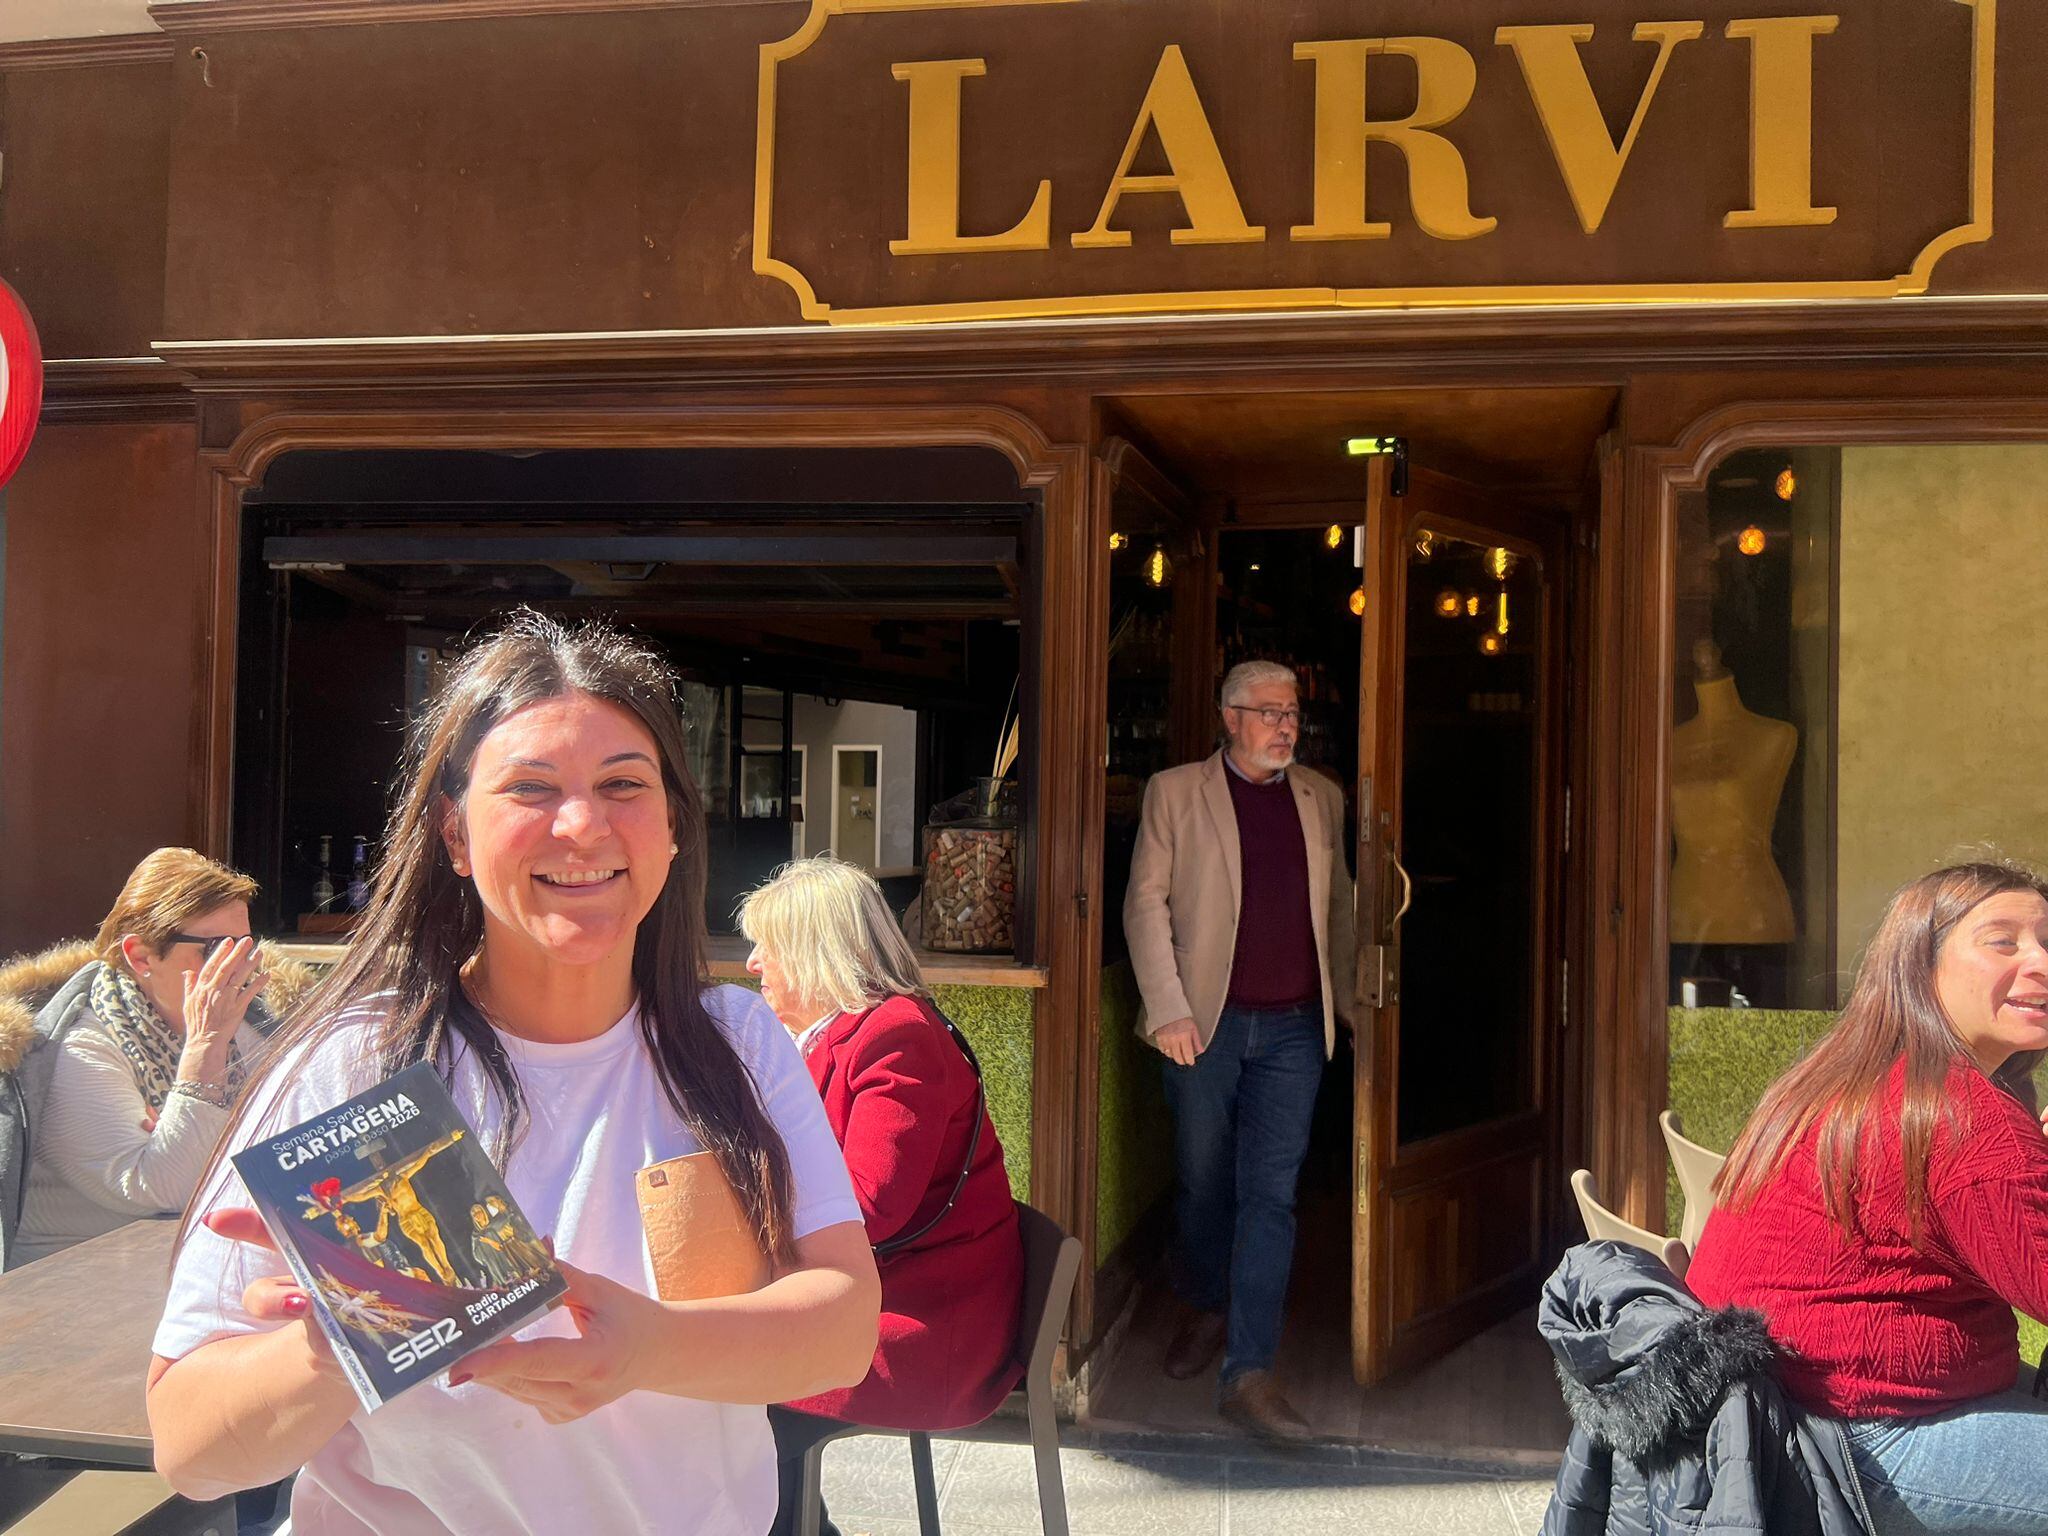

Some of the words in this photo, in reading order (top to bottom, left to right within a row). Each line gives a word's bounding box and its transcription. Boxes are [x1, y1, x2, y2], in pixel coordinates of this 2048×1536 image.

[888, 14, 1841, 255] LARVI
[272, 1124, 326, 1155] Semana
[326, 1103, 366, 1129] Santa
[277, 1093, 415, 1171] CARTAGENA
[324, 1145, 351, 1165] paso
[354, 1139, 361, 1147] a
[363, 1124, 389, 1145] paso
[388, 1105, 421, 1129] 2026
[465, 1292, 498, 1316] Radio
[471, 1278, 540, 1326] CARTAGENA
[386, 1317, 463, 1374] SER
